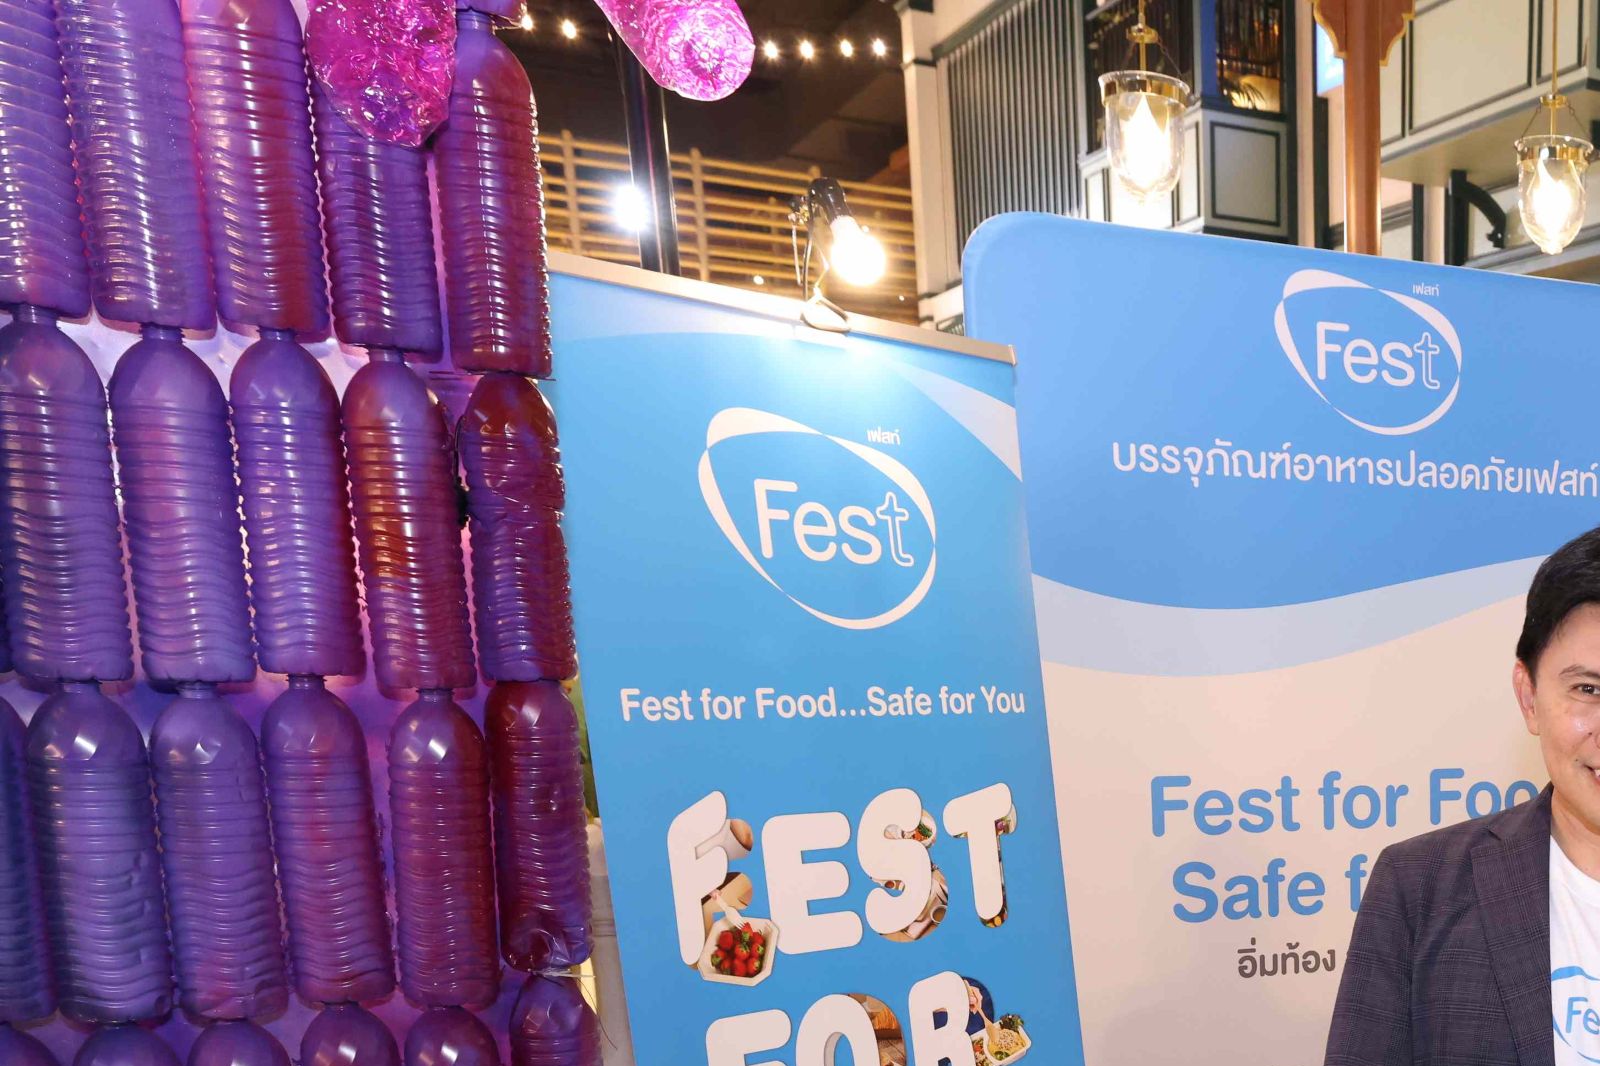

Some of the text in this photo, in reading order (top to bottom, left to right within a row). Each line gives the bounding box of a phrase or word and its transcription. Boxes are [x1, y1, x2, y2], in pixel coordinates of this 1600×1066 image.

[1316, 321, 1440, 390] Fest
[1112, 438, 1599, 498] บรรจุภัณฑ์อาหารปลอดภัยเฟสท์
[754, 478, 914, 567] Fest
[620, 687, 694, 722] Fest
[700, 687, 746, 720] for
[939, 686, 976, 716] for
[981, 686, 1026, 714] You
[1150, 768, 1538, 837] Fest for Foo
[667, 782, 1016, 968] FEST
[1172, 858, 1325, 923] Safe
[1238, 937, 1336, 979] อิ่มท้อง
